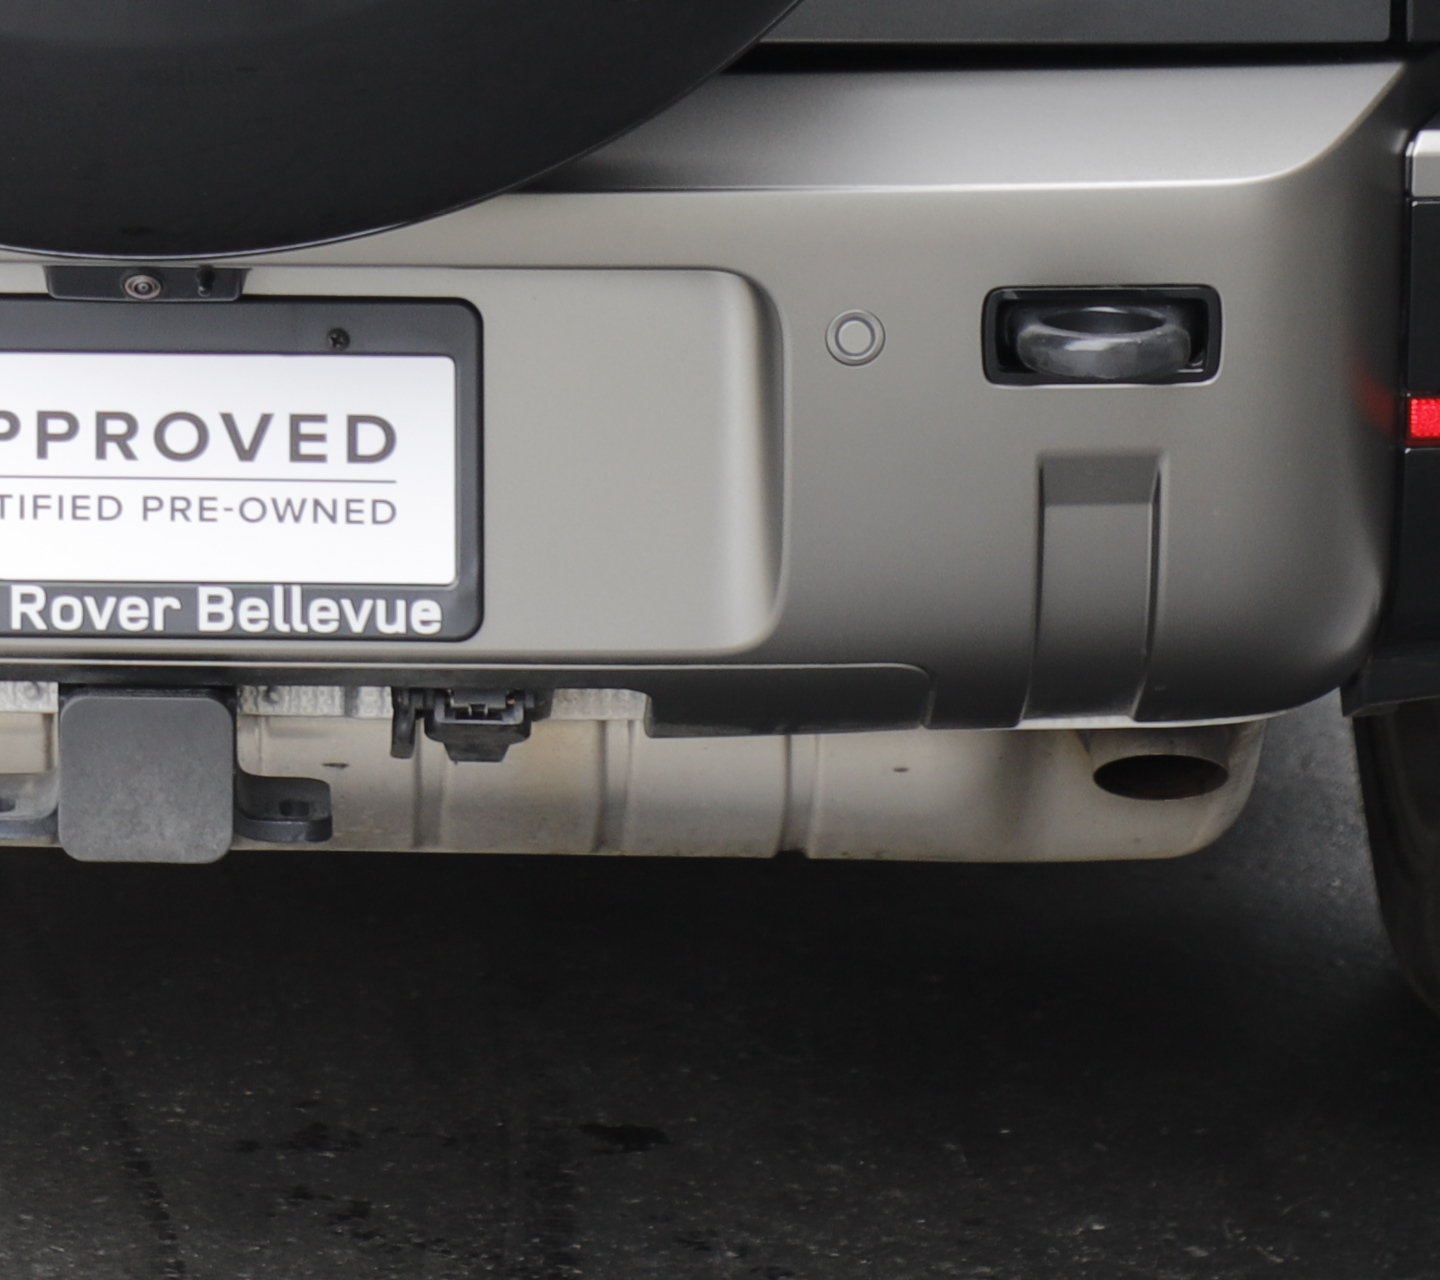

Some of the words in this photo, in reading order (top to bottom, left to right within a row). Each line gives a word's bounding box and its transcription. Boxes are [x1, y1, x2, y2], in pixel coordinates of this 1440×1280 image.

[141, 496, 397, 526] PRE-OWNED
[10, 586, 180, 634] Rover
[198, 586, 443, 636] Bellevue
